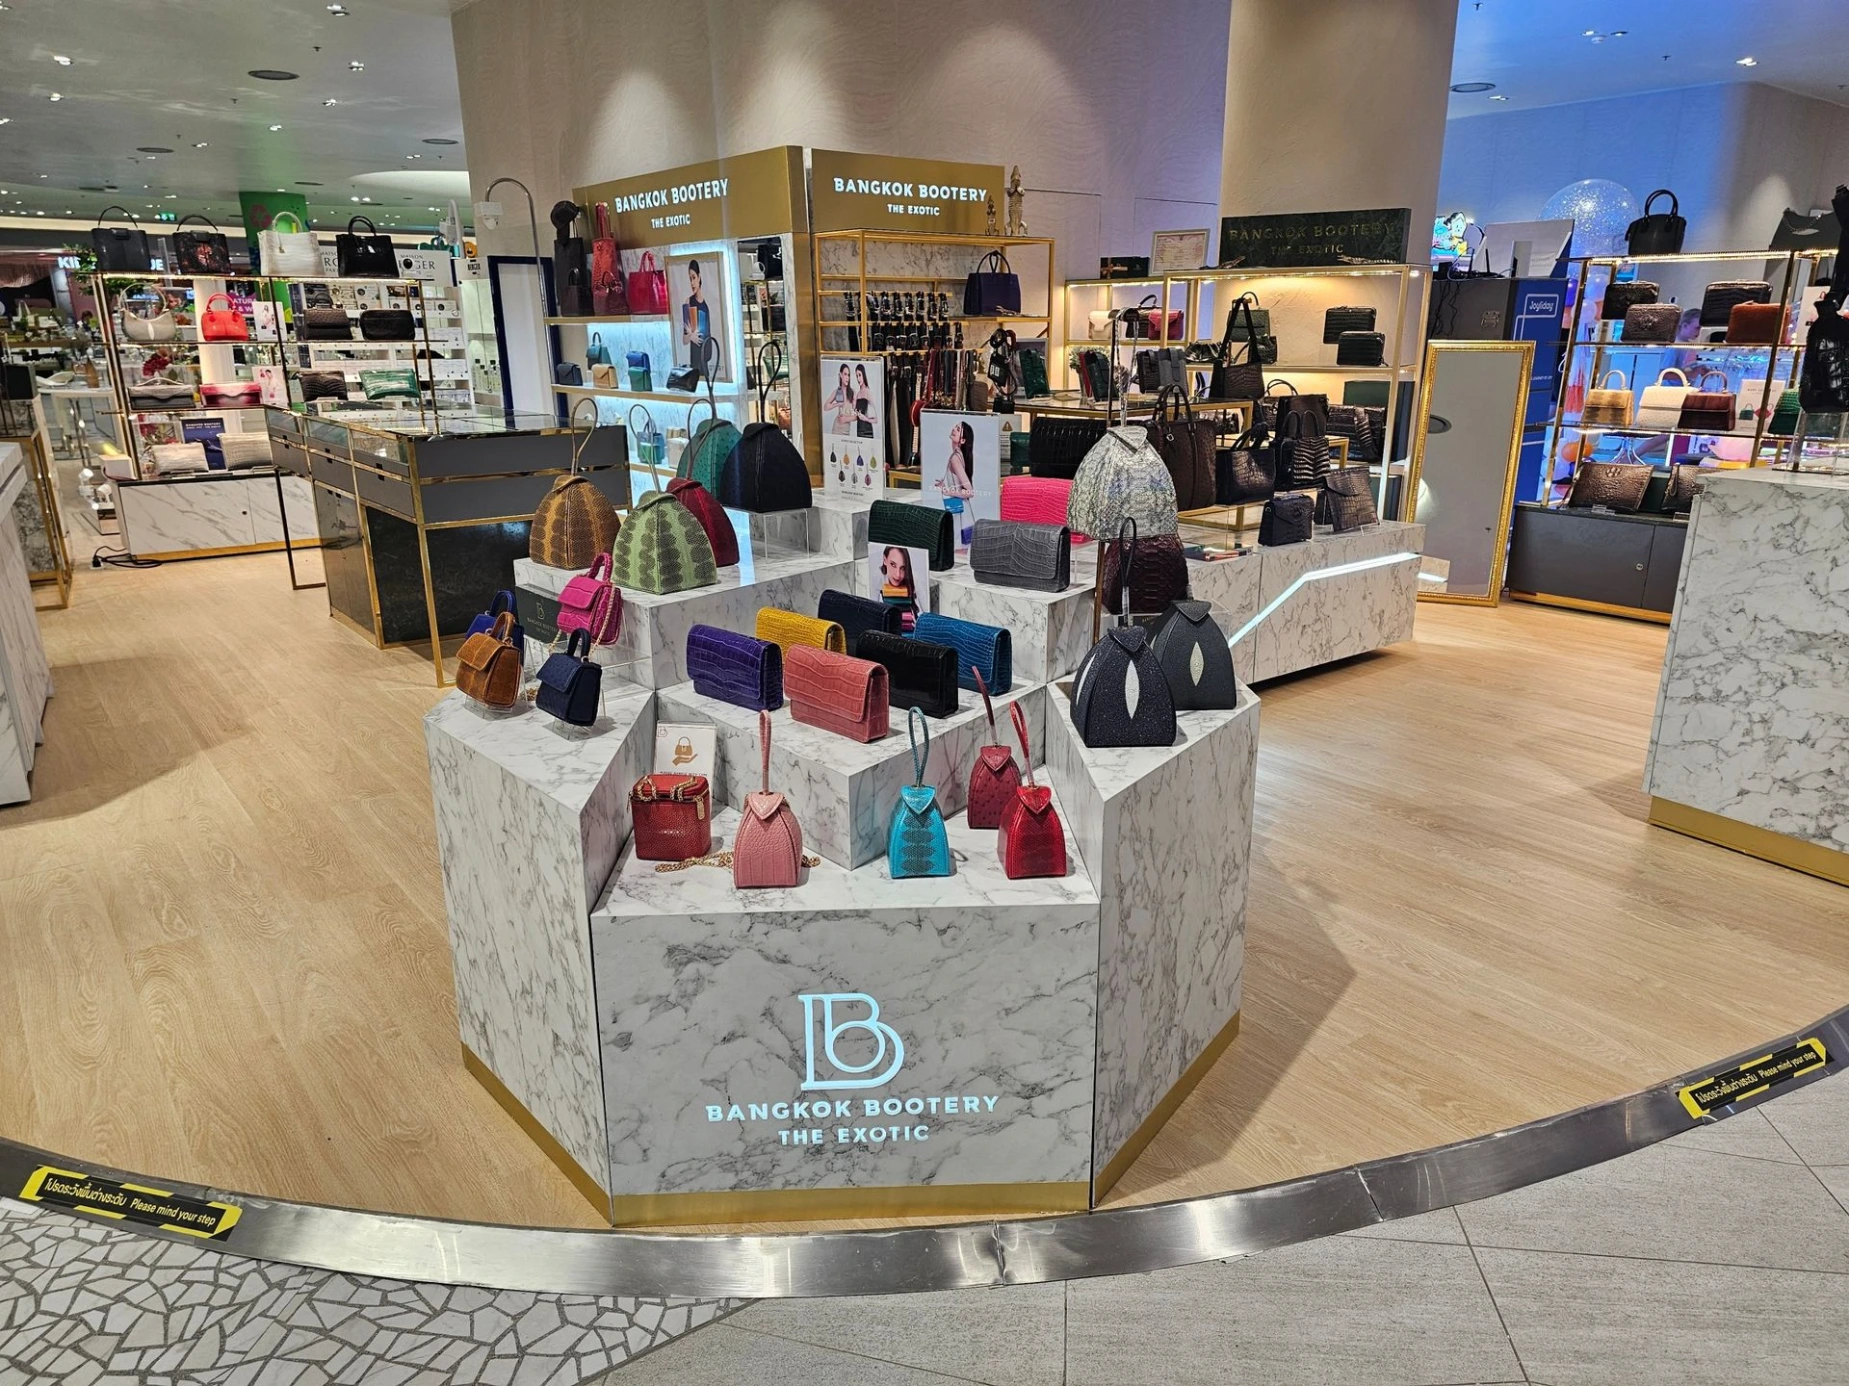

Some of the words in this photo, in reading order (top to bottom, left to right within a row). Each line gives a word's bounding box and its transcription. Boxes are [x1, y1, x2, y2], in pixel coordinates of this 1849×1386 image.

[615, 189, 668, 213] BANGKOK
[671, 178, 728, 204] BOOTERY
[834, 177, 913, 197] BANGKOK
[918, 184, 987, 202] BOOTERY
[651, 218, 664, 229] THE
[666, 214, 691, 227] EXOTIC
[887, 204, 904, 214] THE
[908, 205, 940, 216] EXOTIC
[1757, 1066, 1779, 1079] Please
[1777, 1059, 1793, 1071] mind
[1790, 1056, 1804, 1068] your
[1803, 1051, 1817, 1061] step
[705, 1100, 852, 1122] BANGKOK
[863, 1095, 999, 1117] BOOTERY
[778, 1129, 823, 1146] THE
[838, 1125, 930, 1144] EXOTIC
[129, 1197, 157, 1213] Please
[156, 1204, 180, 1217] mind
[176, 1209, 198, 1221] your
[197, 1214, 216, 1228] step
